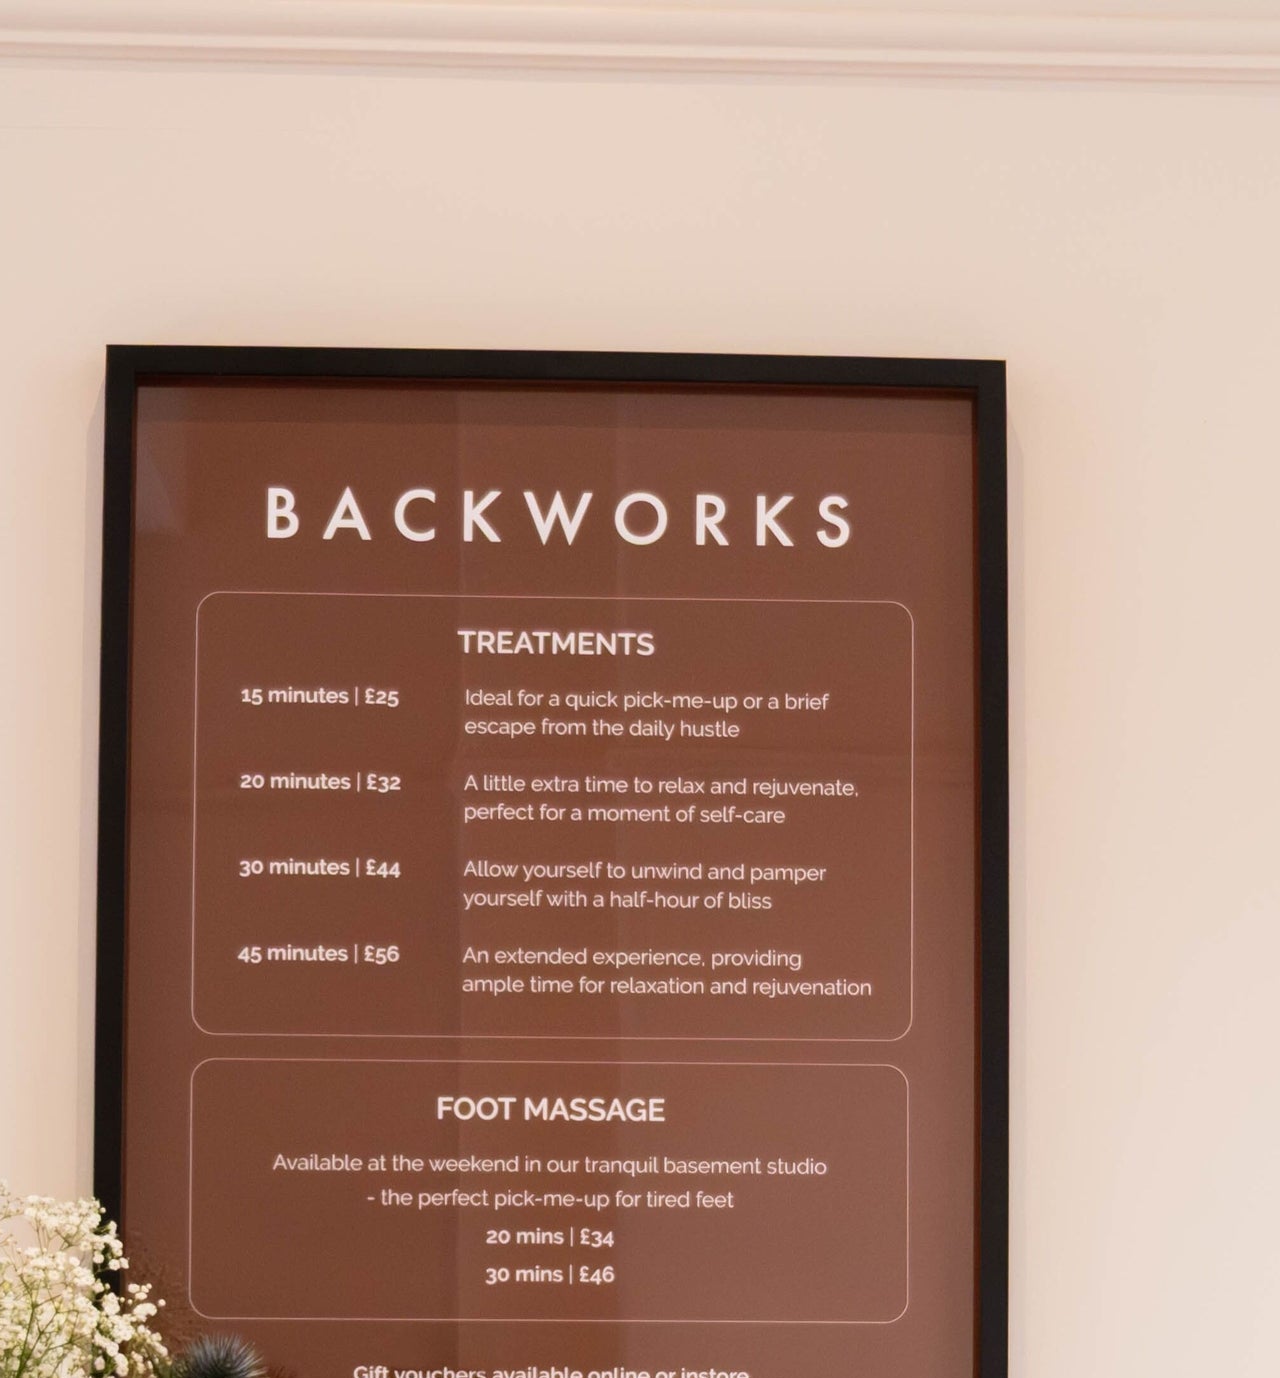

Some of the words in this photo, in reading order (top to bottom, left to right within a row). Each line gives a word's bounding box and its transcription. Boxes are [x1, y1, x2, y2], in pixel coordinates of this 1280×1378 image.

[266, 486, 850, 548] BACKWORKS
[457, 629, 655, 656] TREATMENTS
[241, 688, 263, 705] 15
[268, 686, 349, 704] minutes
[364, 687, 399, 707] £25
[465, 688, 513, 706] Ideal
[516, 688, 544, 706] for
[548, 693, 560, 706] a
[564, 690, 618, 711] quick
[623, 691, 738, 713] pick-me-up
[742, 696, 763, 709] or
[767, 696, 779, 709] a
[784, 692, 829, 710] brief
[464, 720, 536, 738] escape
[541, 717, 587, 735] from
[591, 718, 624, 736] the
[628, 719, 675, 741] daily
[680, 719, 740, 737] hustle
[240, 773, 265, 788] 20
[270, 771, 351, 790] minutes
[366, 772, 401, 793] £32
[463, 774, 478, 790] A
[483, 774, 526, 791] little
[530, 775, 579, 792] extra
[584, 775, 629, 793] time
[633, 776, 653, 793] to
[658, 776, 705, 794] relax
[710, 777, 747, 794] and
[752, 778, 858, 798] rejuvenate,
[464, 802, 534, 823] perfect
[539, 803, 566, 820] for
[570, 807, 582, 821] a
[587, 805, 671, 822] moment
[675, 804, 696, 822] of
[700, 805, 786, 823] self-care
[239, 859, 264, 877] 30
[269, 857, 350, 875] minutes
[365, 858, 401, 878] £44
[463, 860, 519, 877] Allow
[522, 860, 603, 882] yourself
[606, 862, 626, 879] to
[631, 862, 702, 880] unwind
[707, 863, 745, 880] and
[750, 867, 826, 885] pamper
[463, 889, 543, 910] yourself
[546, 890, 587, 907] with
[592, 894, 604, 907] a
[610, 890, 699, 908] half-hour
[703, 891, 724, 909] of
[728, 891, 772, 909] bliss
[237, 945, 262, 963] 45
[266, 943, 348, 961] minutes
[363, 944, 400, 965] £56
[462, 946, 489, 963] An
[494, 947, 587, 964] extended
[592, 948, 704, 968] experience,
[711, 949, 802, 971] providing
[462, 975, 524, 996] ample
[529, 975, 574, 993] time
[578, 975, 605, 993] for
[610, 976, 704, 994] relaxation
[709, 977, 747, 994] and
[752, 978, 872, 998] rejuvenation
[437, 1096, 516, 1120] FOOT
[524, 1096, 665, 1121] MASSAGE
[272, 1153, 363, 1171] Available
[367, 1154, 387, 1171] at
[392, 1154, 424, 1172] the
[428, 1154, 519, 1172] weekend
[524, 1155, 541, 1172] in
[546, 1159, 579, 1173] our
[584, 1156, 659, 1177] tranquil
[663, 1156, 762, 1174] basement
[767, 1157, 827, 1175] studio
[380, 1188, 413, 1206] the
[417, 1188, 489, 1210] perfect
[494, 1189, 610, 1211] pick-me-up
[614, 1190, 641, 1207] for
[646, 1190, 690, 1208] tired
[695, 1190, 734, 1208] feet
[485, 1229, 511, 1244] 20
[516, 1227, 564, 1245] mins
[579, 1227, 614, 1248] £34
[485, 1267, 510, 1285] 30
[515, 1265, 563, 1282] mins
[579, 1265, 615, 1285] £46
